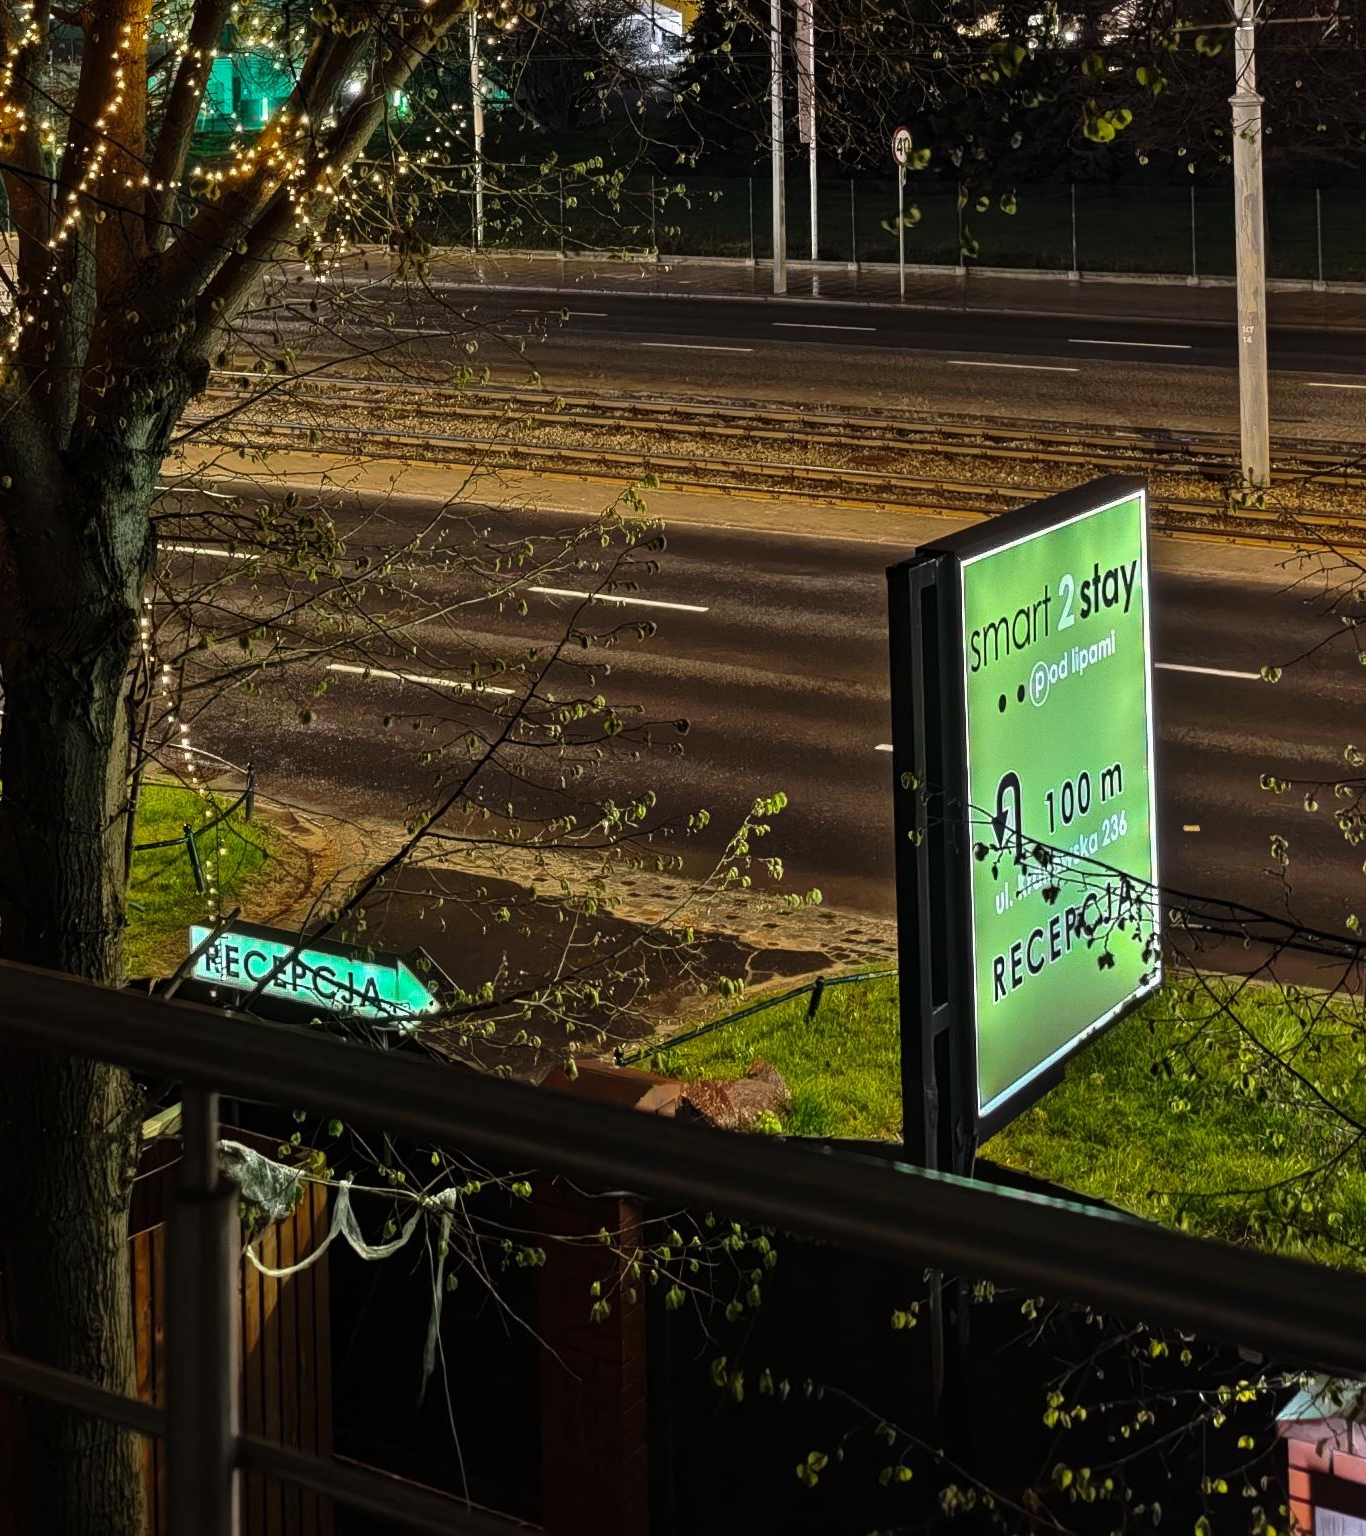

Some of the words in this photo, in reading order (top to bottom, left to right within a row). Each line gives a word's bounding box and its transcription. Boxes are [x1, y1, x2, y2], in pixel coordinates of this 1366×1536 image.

[897, 136, 911, 155] 40
[970, 584, 1052, 672] smart
[1071, 630, 1116, 676] lipami
[1044, 770, 1090, 835] 100
[1100, 761, 1123, 803] m
[995, 881, 1014, 915] ul.
[1102, 810, 1128, 846] 236
[993, 874, 1133, 1004] RECEPCJA
